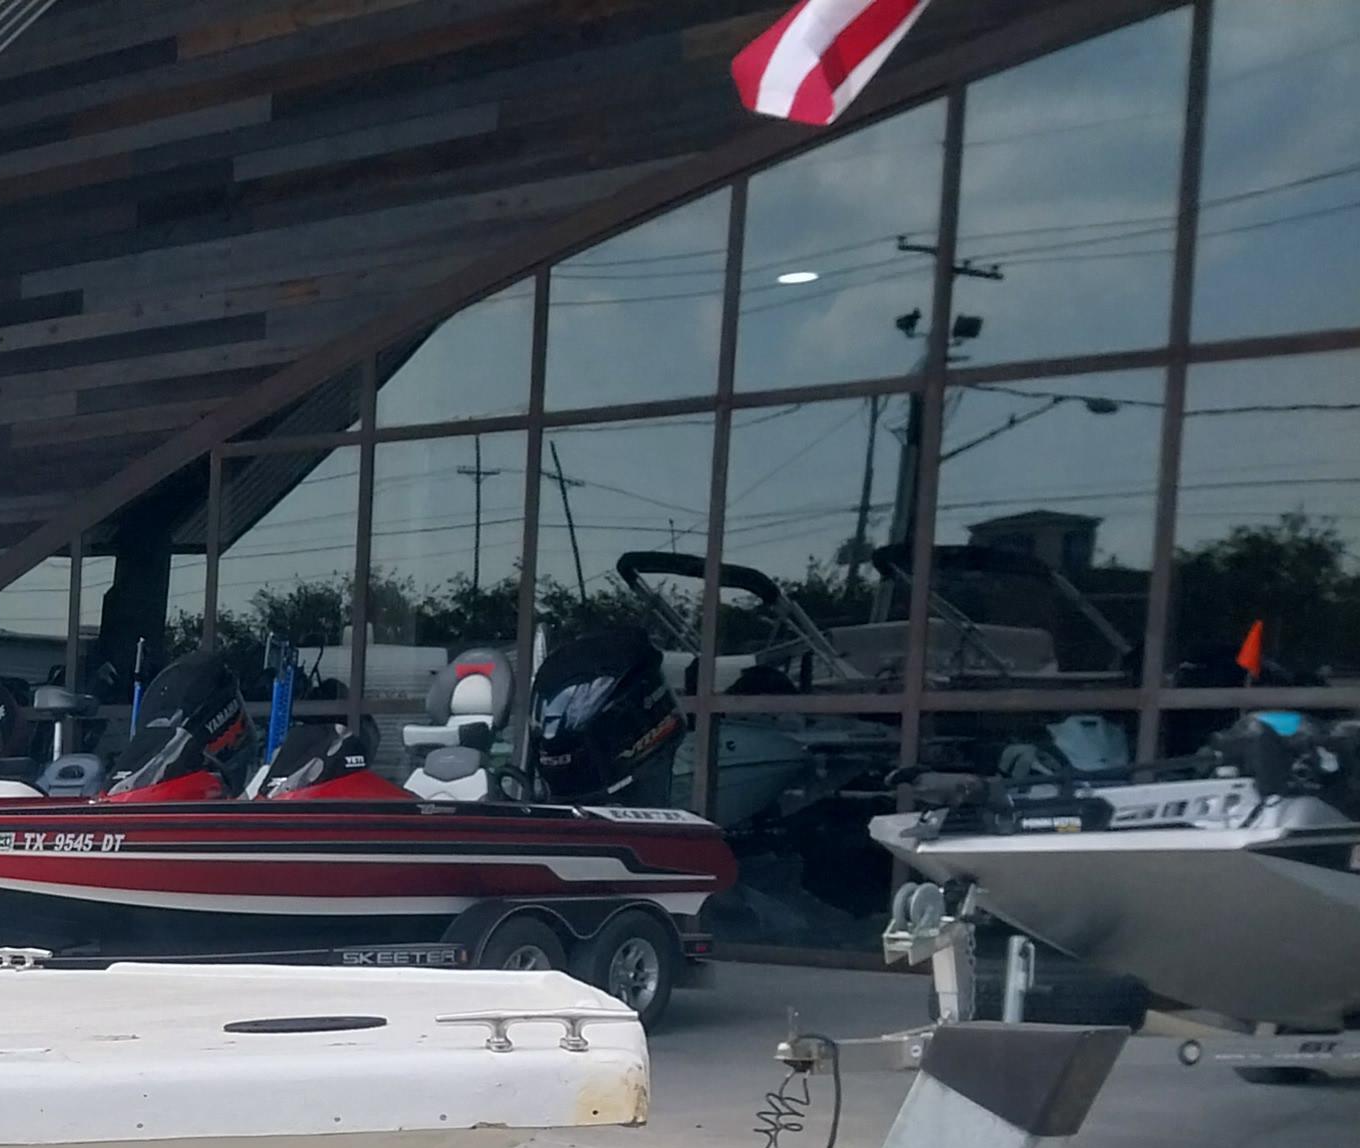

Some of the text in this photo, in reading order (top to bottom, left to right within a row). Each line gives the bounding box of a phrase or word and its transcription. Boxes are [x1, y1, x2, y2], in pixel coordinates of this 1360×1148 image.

[204, 699, 239, 734] YAMAHA
[345, 755, 365, 765] YETI
[24, 832, 47, 851] TX
[54, 833, 95, 851] 9545
[101, 833, 126, 852] DT
[343, 950, 455, 965] SKEETER
